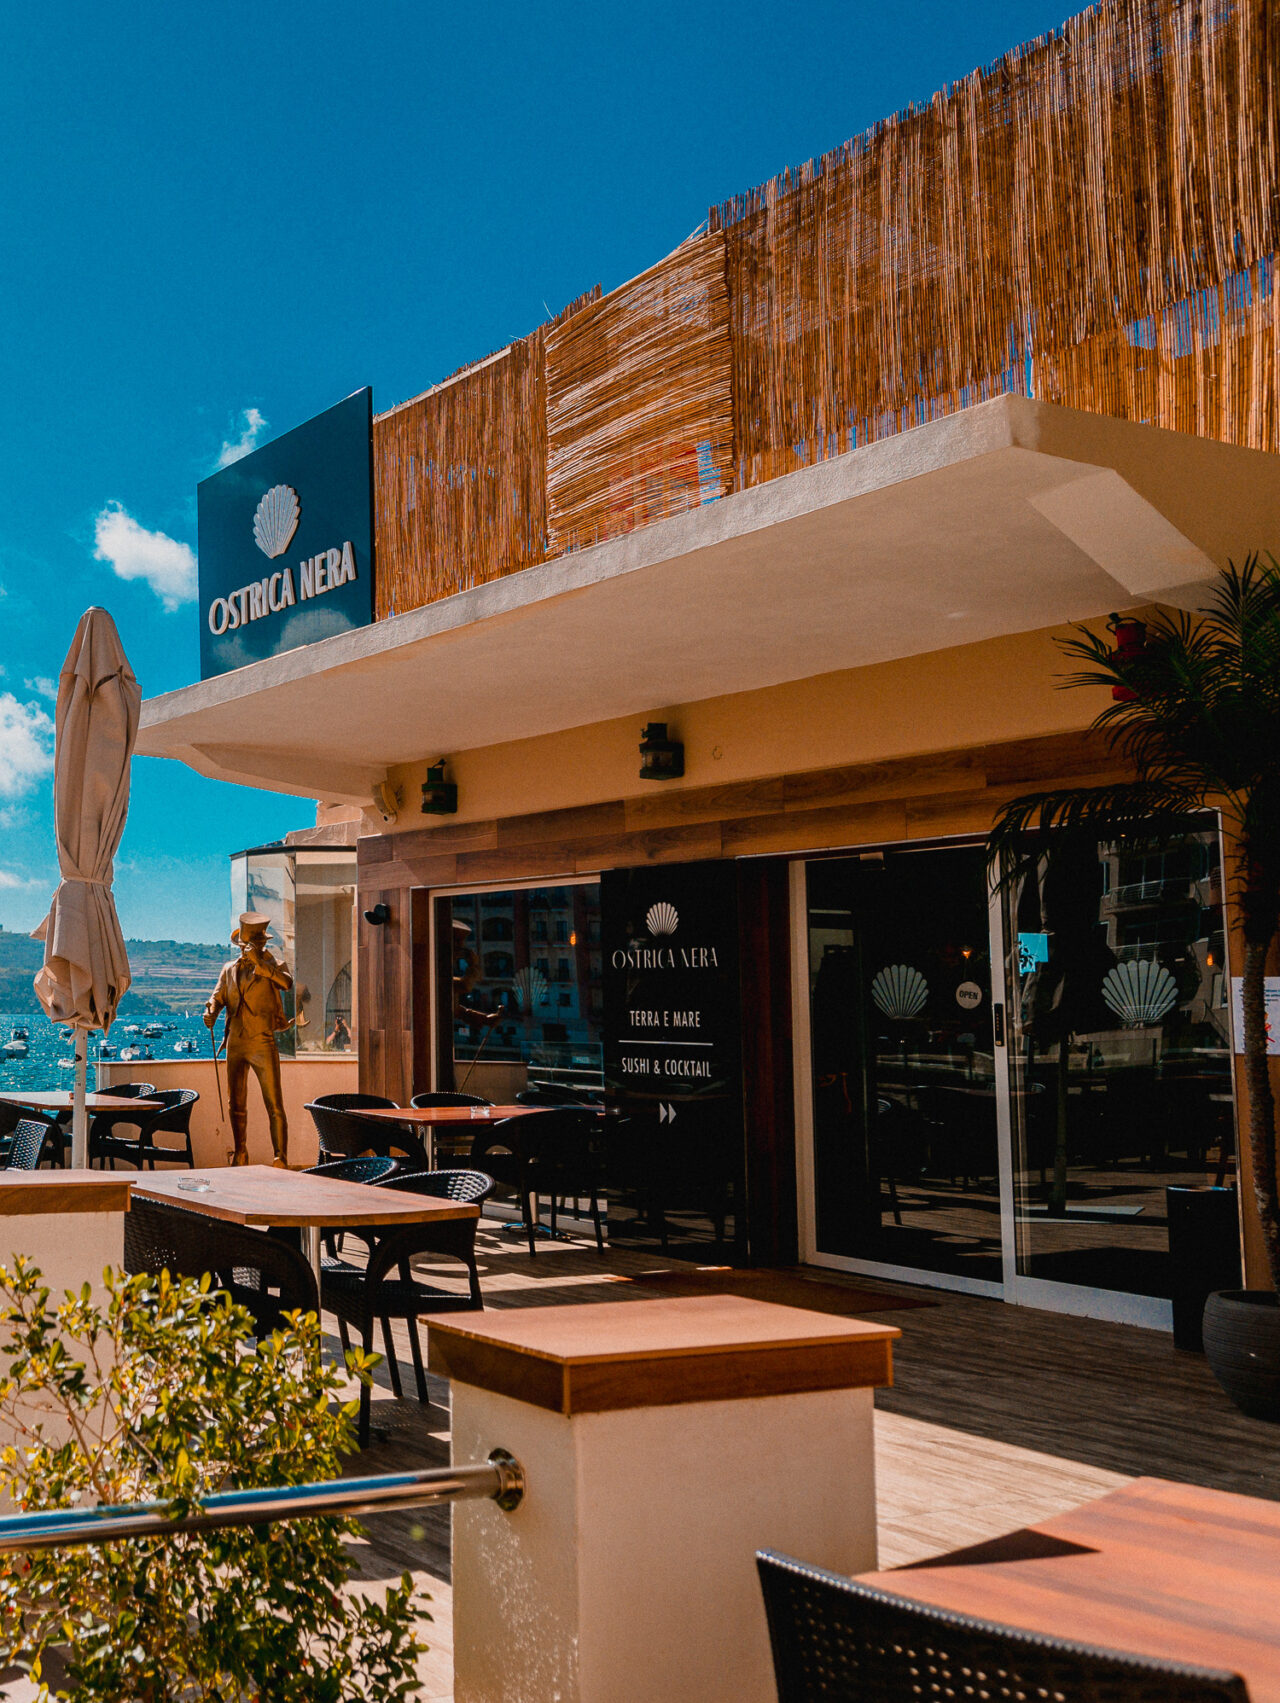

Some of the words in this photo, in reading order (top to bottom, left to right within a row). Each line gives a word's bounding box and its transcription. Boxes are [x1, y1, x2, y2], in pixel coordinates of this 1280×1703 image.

[209, 568, 296, 634] OSTRICA
[300, 541, 357, 600] NERA
[612, 948, 675, 969] OSTRICA
[681, 947, 718, 968] NERA
[959, 990, 978, 1000] OPEN
[629, 1010, 660, 1027] TERRA
[663, 1010, 670, 1027] E
[673, 1011, 701, 1028] MARE
[621, 1057, 650, 1074] SUSHI
[653, 1059, 661, 1075] &
[664, 1059, 712, 1078] COCKTAIL
